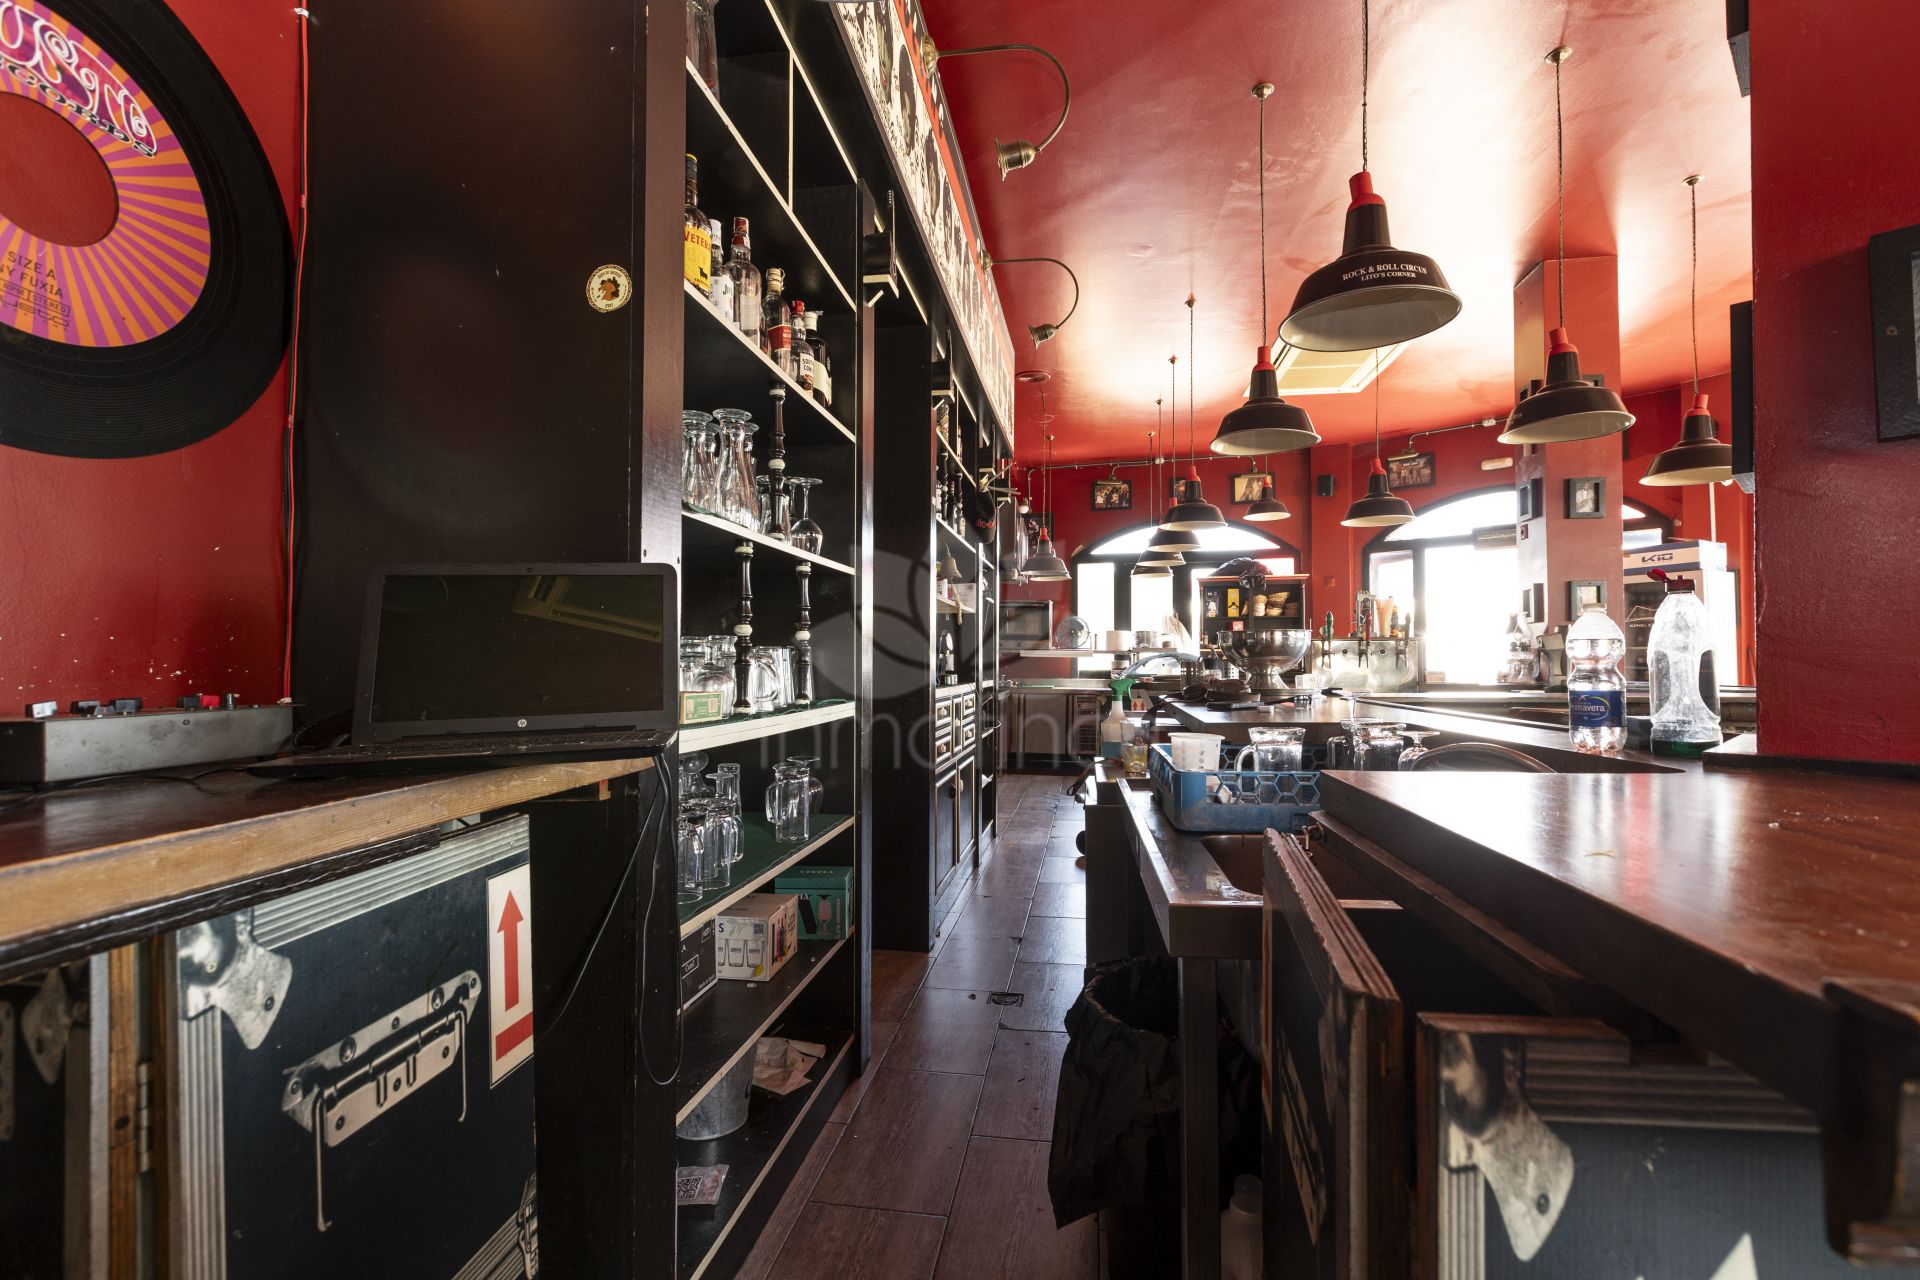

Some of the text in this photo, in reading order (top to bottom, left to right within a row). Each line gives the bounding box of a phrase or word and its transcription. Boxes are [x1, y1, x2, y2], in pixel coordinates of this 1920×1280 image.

[0, 55, 157, 158] CORDS
[8, 251, 56, 281] SIZE A
[1342, 263, 1428, 281] ROCK & ROLL CIRCUS
[1361, 271, 1417, 281] LITO'S CORNER
[20, 272, 64, 299] FUXIA
[33, 294, 67, 314] STEREO
